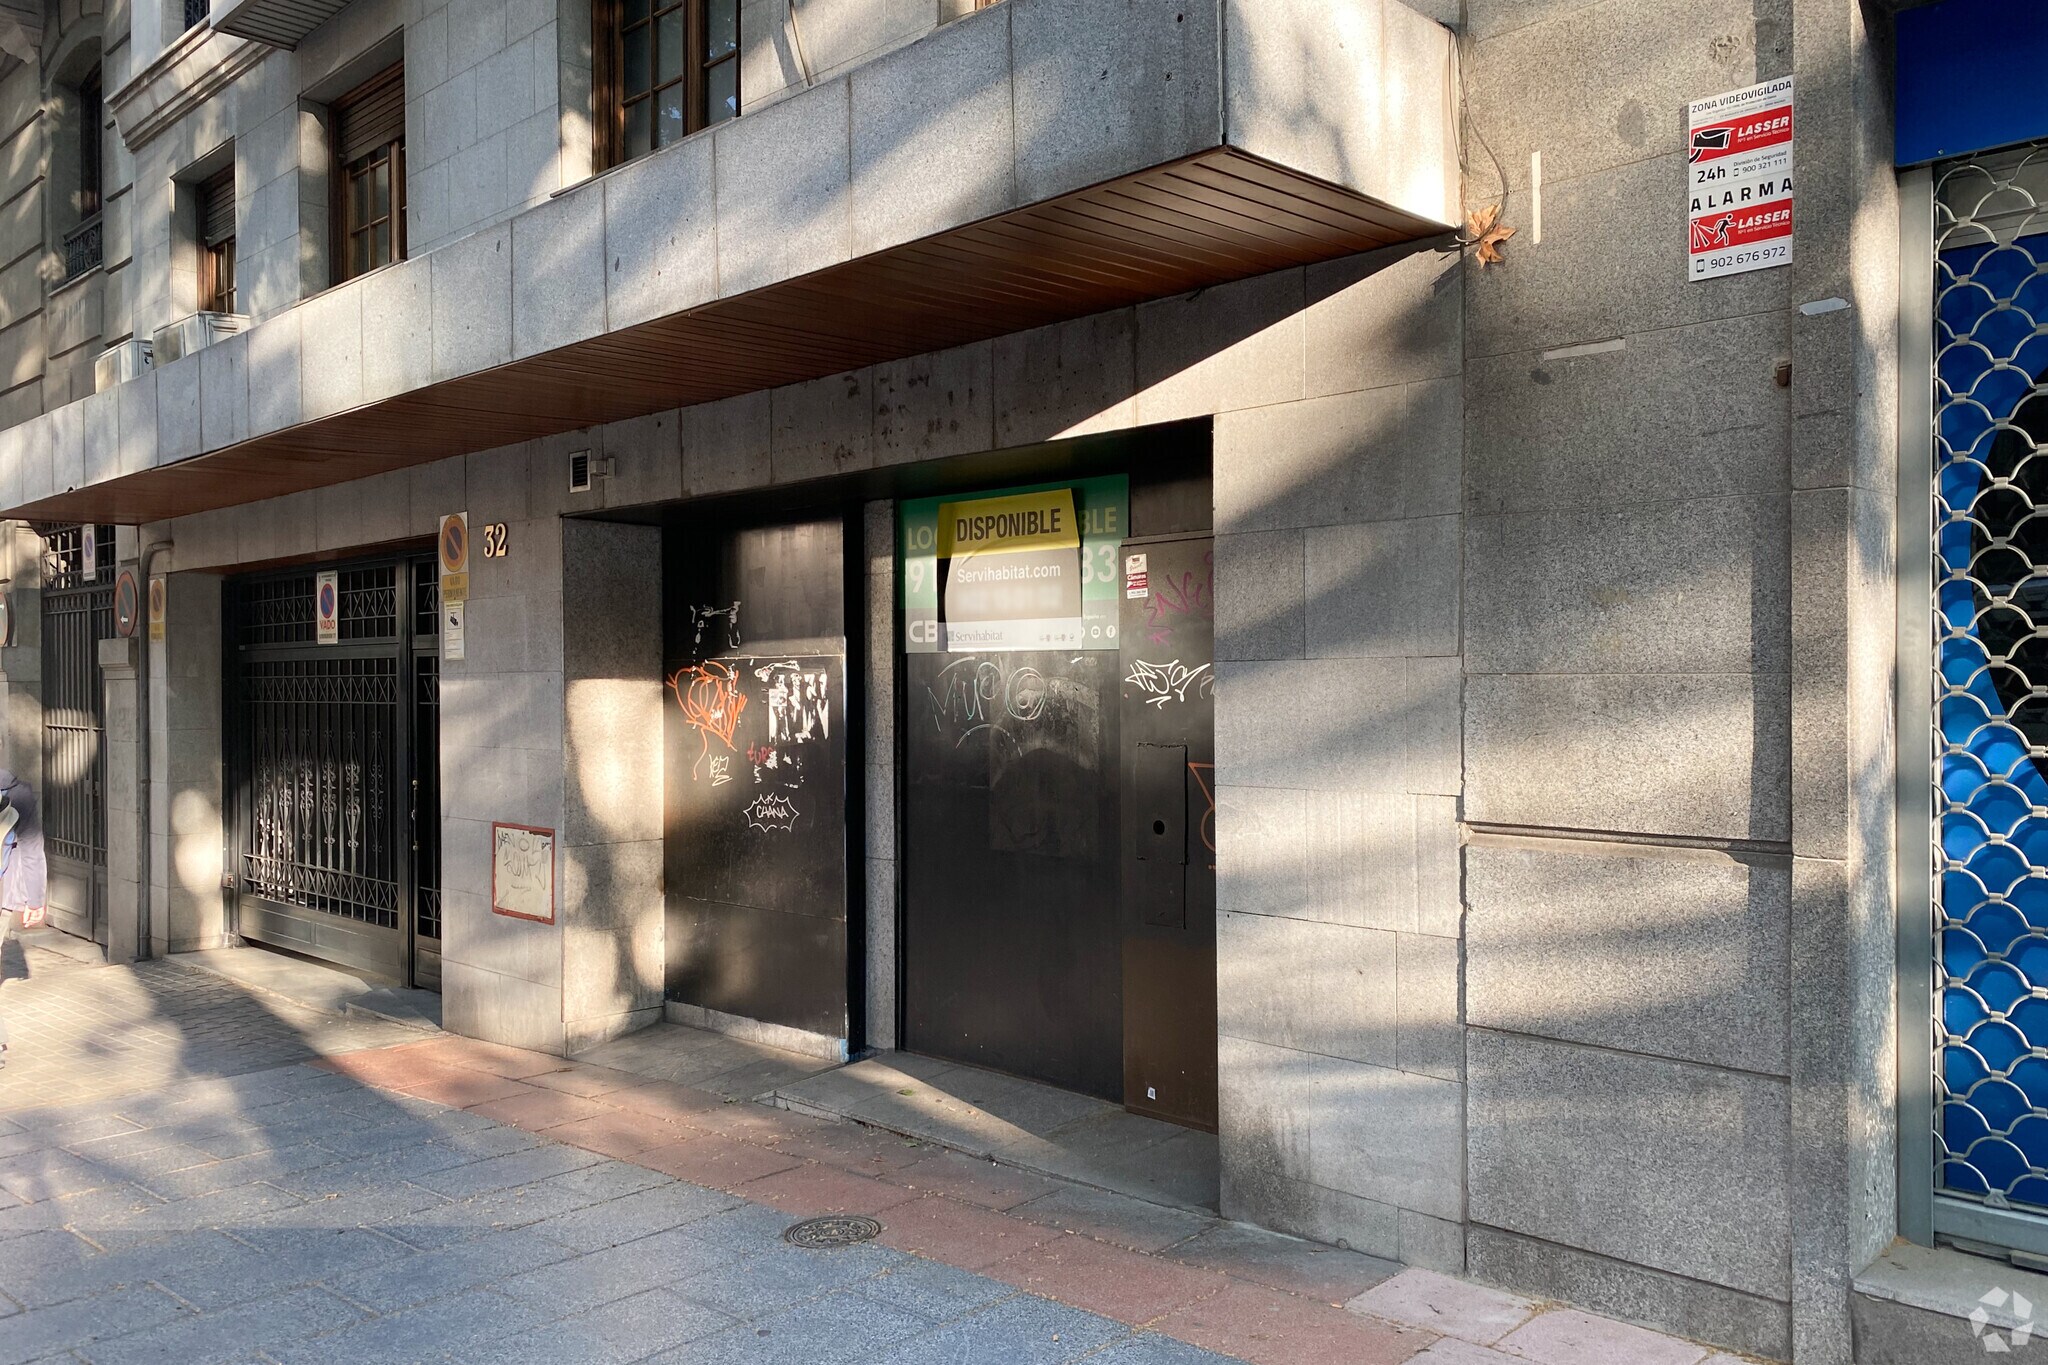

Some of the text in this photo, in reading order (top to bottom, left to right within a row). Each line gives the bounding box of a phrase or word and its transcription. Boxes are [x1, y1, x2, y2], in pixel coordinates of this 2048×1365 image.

[1692, 100, 1718, 113] ZONA
[1719, 80, 1792, 106] VIDEOVIGILADA
[1737, 116, 1790, 138] LASSER
[1754, 131, 1771, 139] Servicio
[1742, 157, 1787, 173] 900 321 111
[1761, 150, 1787, 161] Seguridad
[1697, 166, 1726, 183] 24h
[1690, 177, 1793, 212] ALARMA
[1737, 209, 1790, 229] LASSER
[1710, 246, 1786, 269] 902 676 972
[956, 508, 1061, 542] DISPONIBLE
[483, 523, 508, 558] 32
[908, 525, 938, 550] LO
[957, 564, 1061, 583] Servihabitat.com
[955, 630, 1003, 642] Servihabitat
